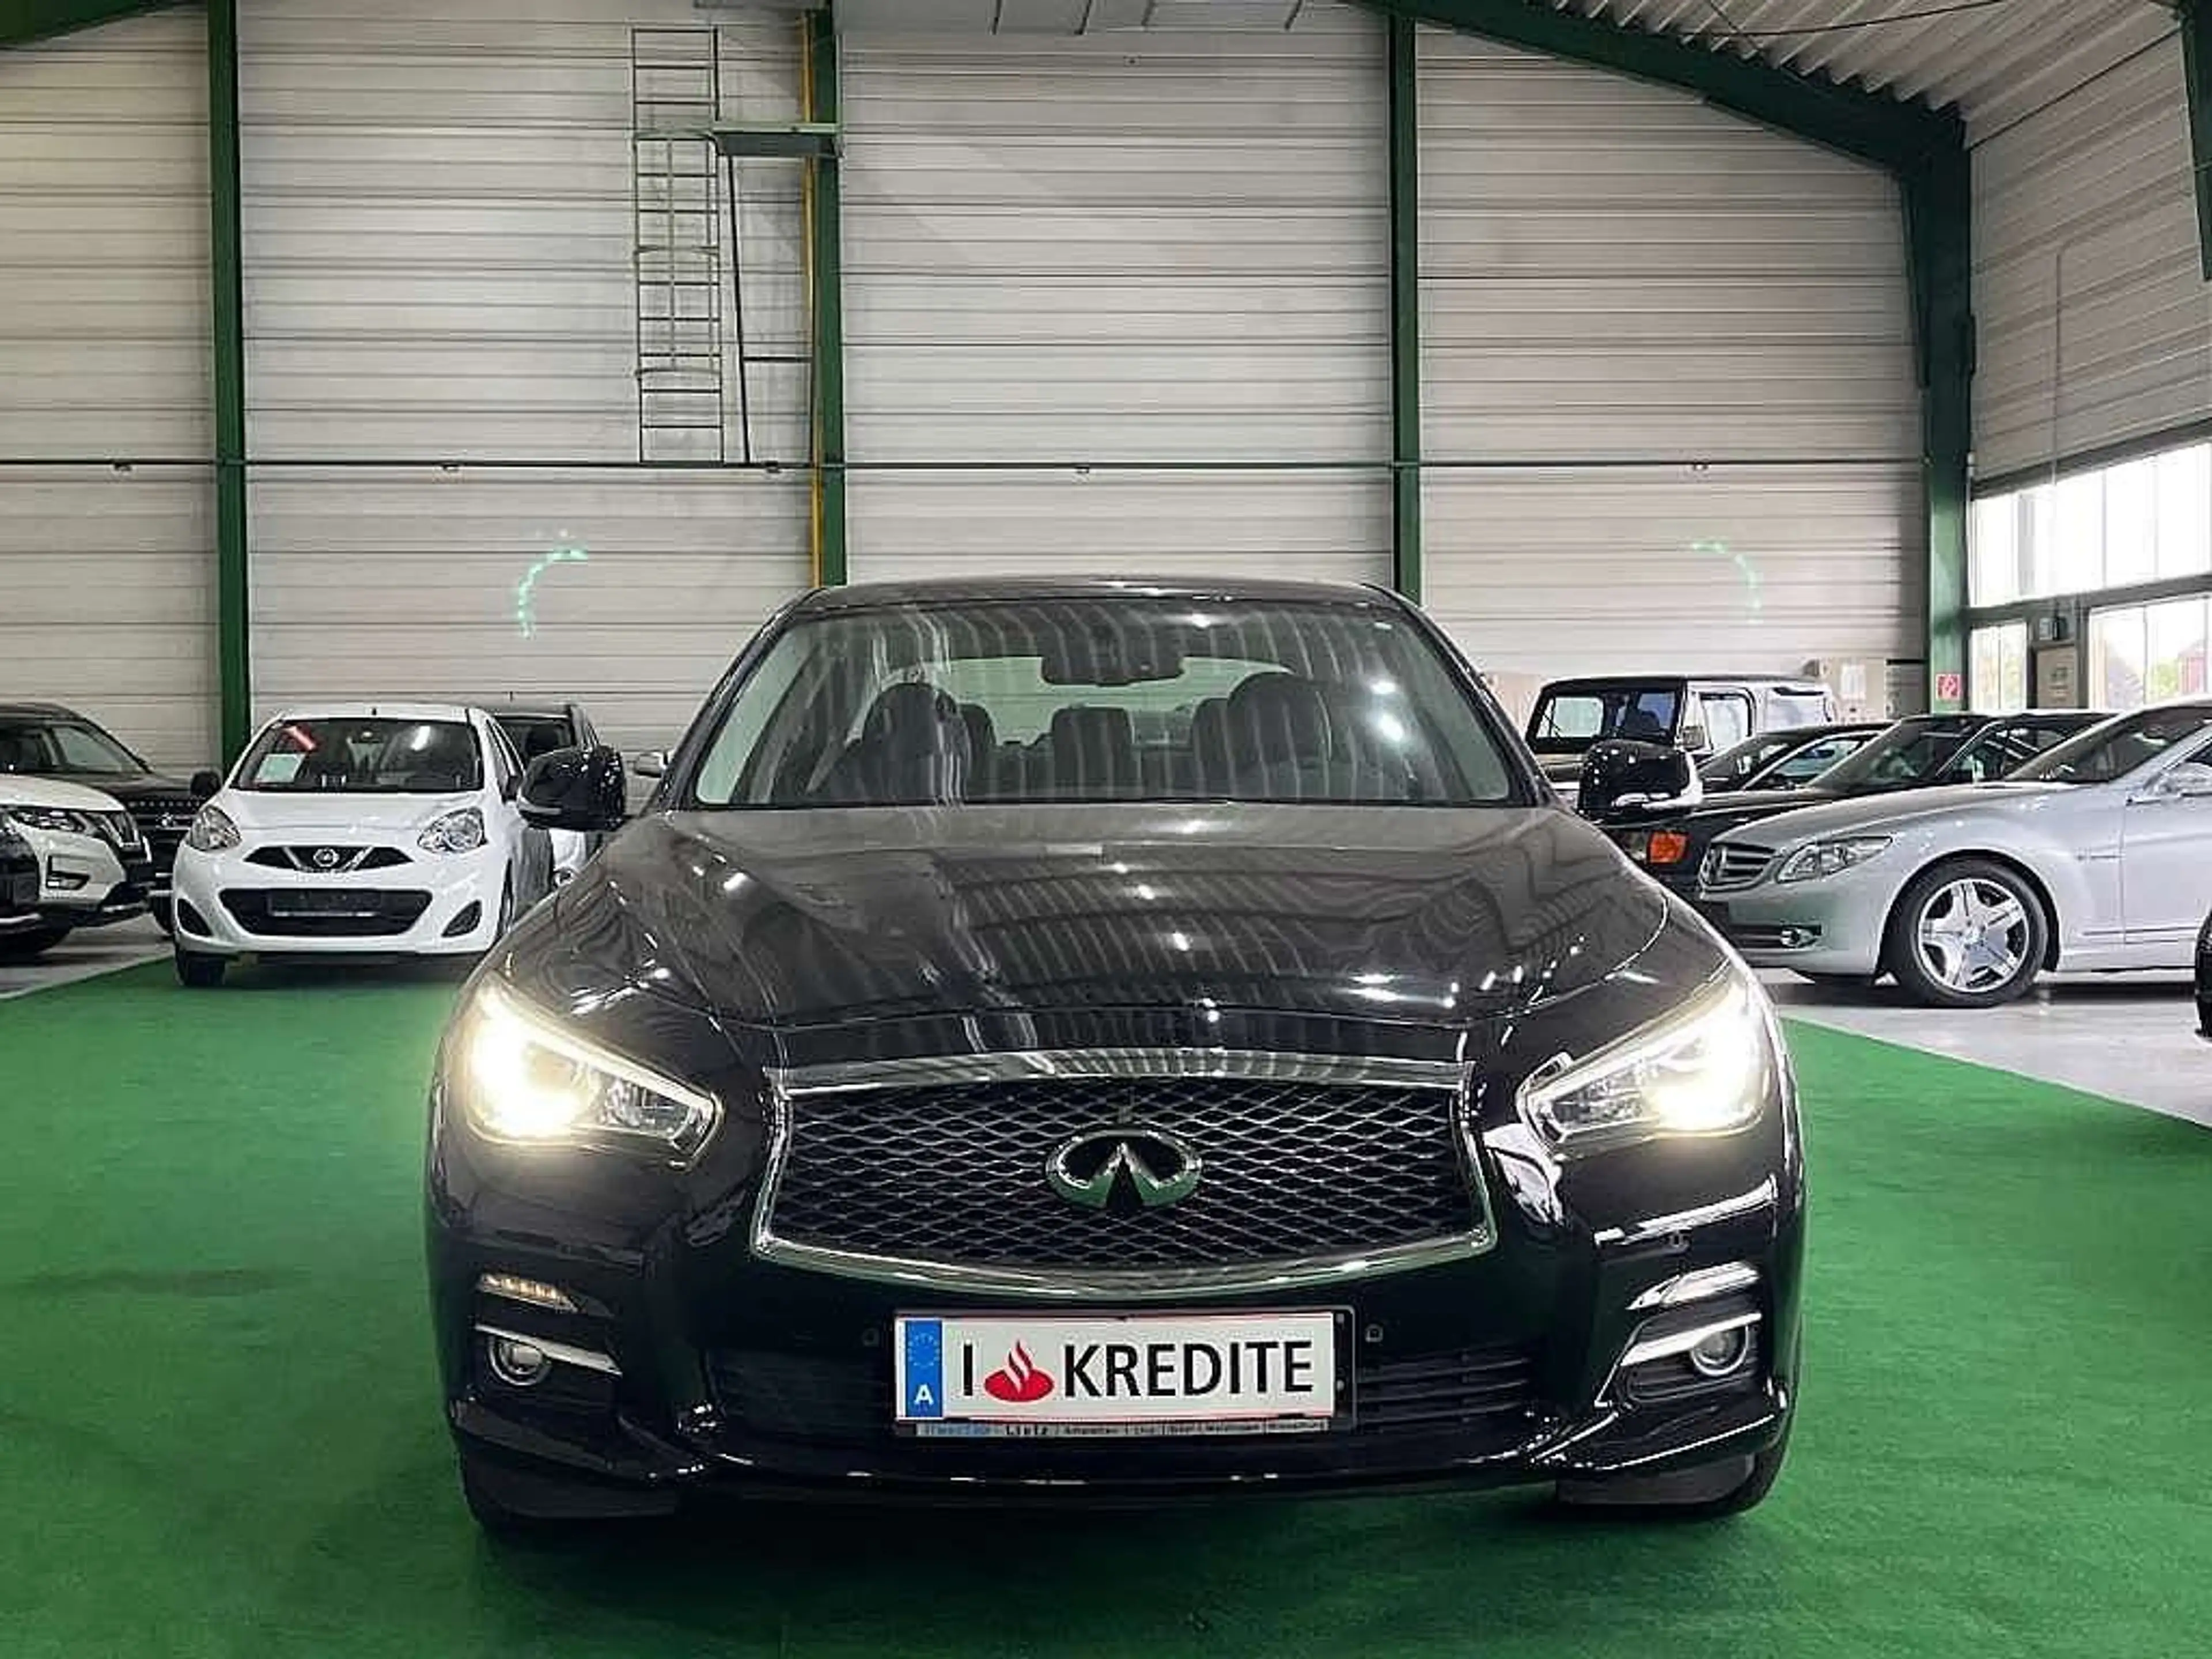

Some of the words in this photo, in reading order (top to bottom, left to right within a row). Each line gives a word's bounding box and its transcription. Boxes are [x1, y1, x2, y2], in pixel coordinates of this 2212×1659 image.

[963, 1344, 974, 1396] I
[1065, 1341, 1313, 1397] KREDITE
[914, 1384, 934, 1406] A
